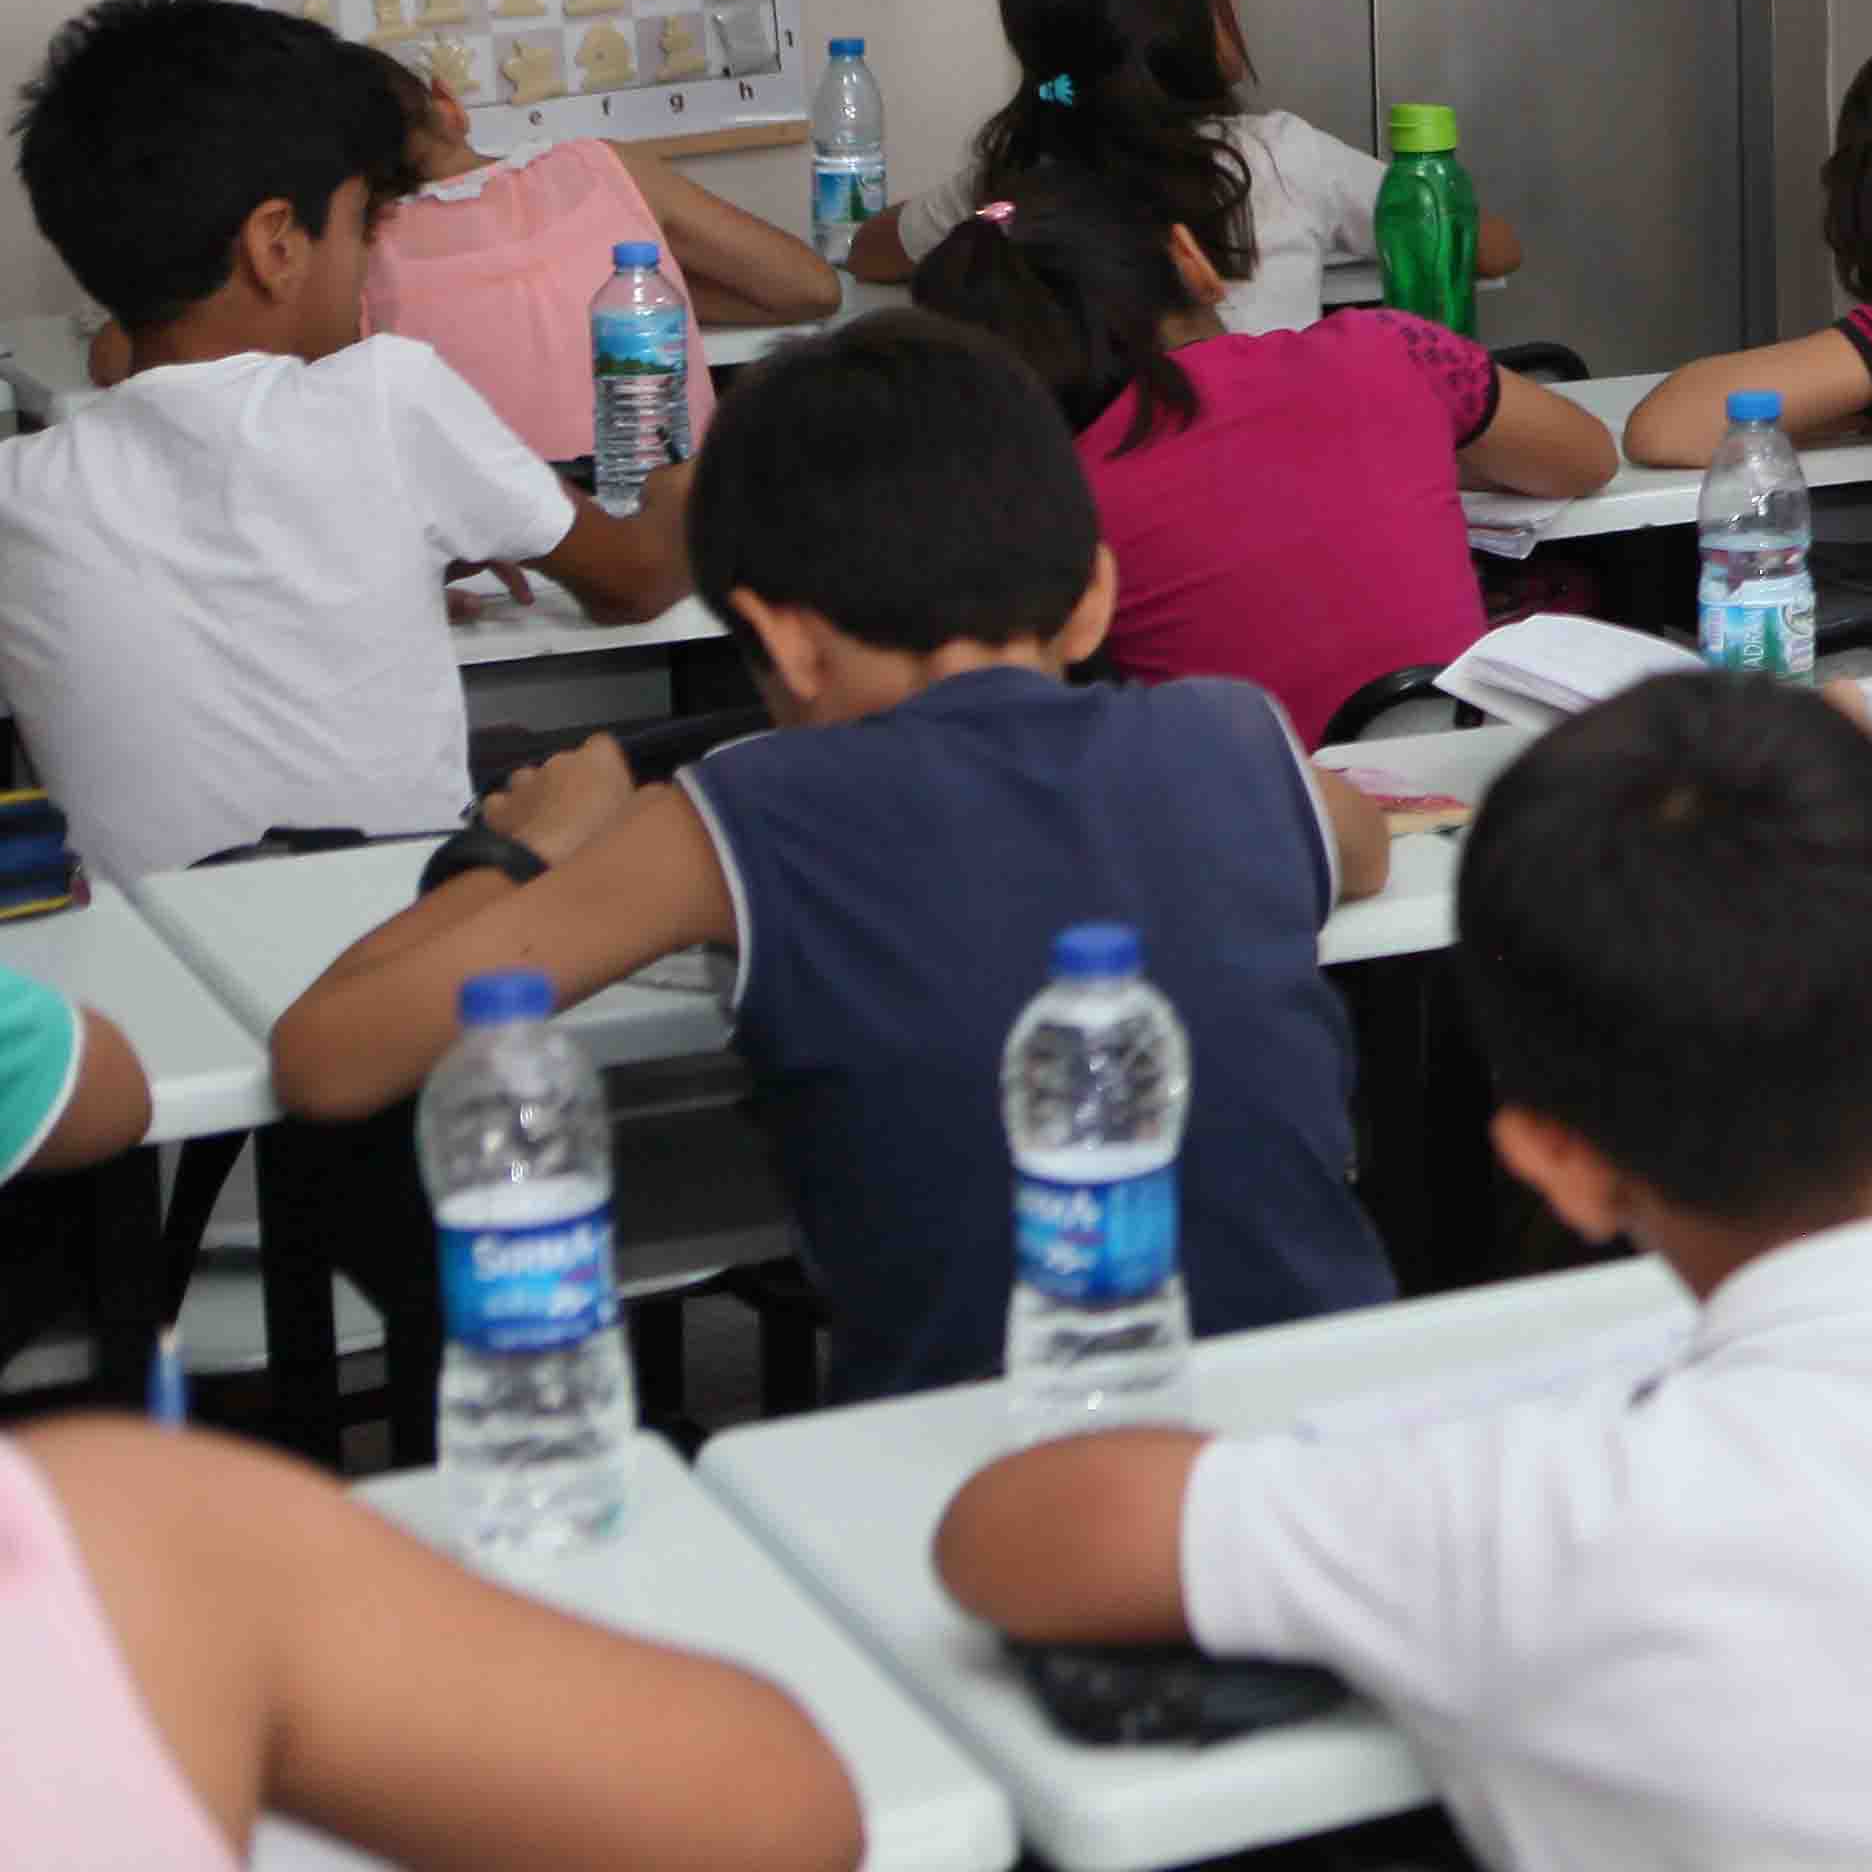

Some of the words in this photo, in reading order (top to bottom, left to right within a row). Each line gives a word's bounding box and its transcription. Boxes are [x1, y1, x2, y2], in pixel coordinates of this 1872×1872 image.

[784, 29, 796, 49] 1
[528, 109, 544, 127] e
[602, 97, 613, 118] f
[668, 93, 686, 116] g
[738, 79, 755, 102] h
